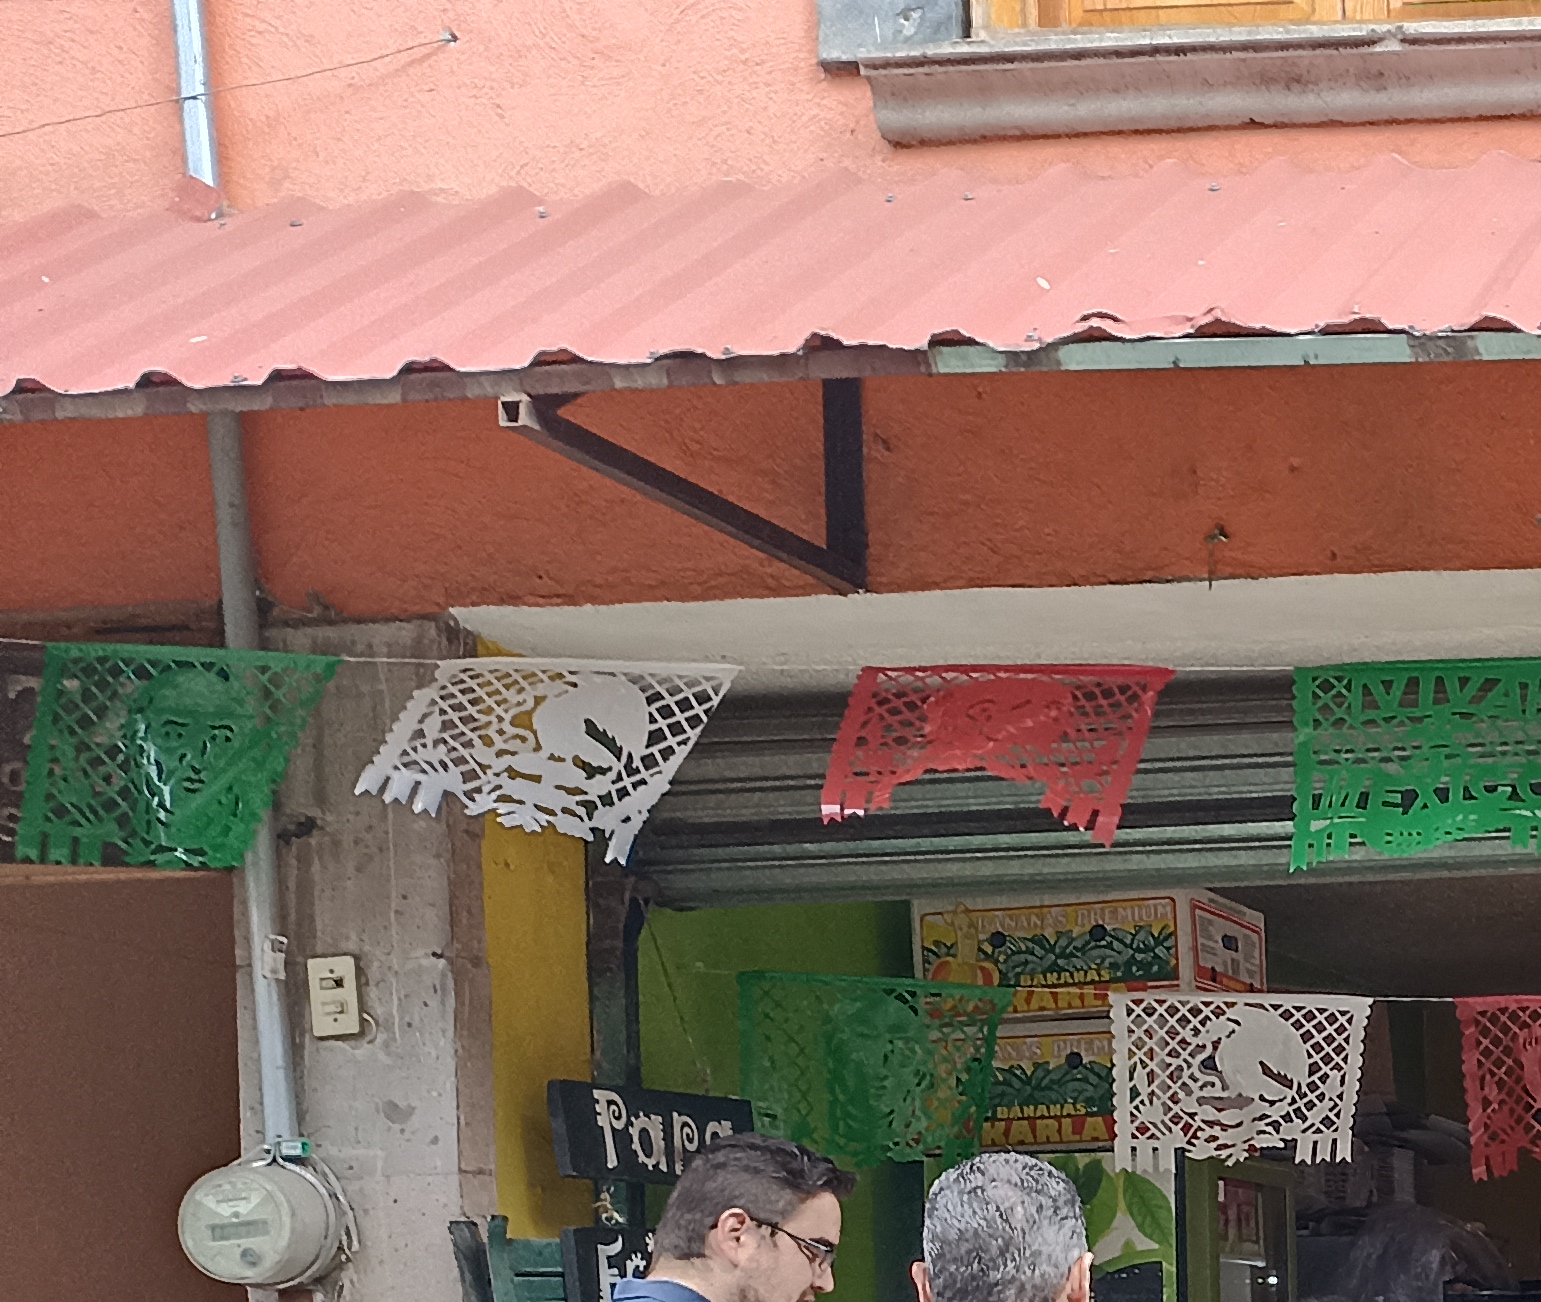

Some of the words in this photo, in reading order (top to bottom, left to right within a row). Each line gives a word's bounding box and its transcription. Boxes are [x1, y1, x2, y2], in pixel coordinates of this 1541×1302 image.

[977, 908, 1067, 932] BANANAS
[1078, 902, 1176, 926] PREMIUM
[1020, 968, 1110, 987] BANANAS
[1009, 984, 1126, 1012] KARL
[996, 1102, 1087, 1119] BANANAS
[981, 1116, 1110, 1146] KARLA
